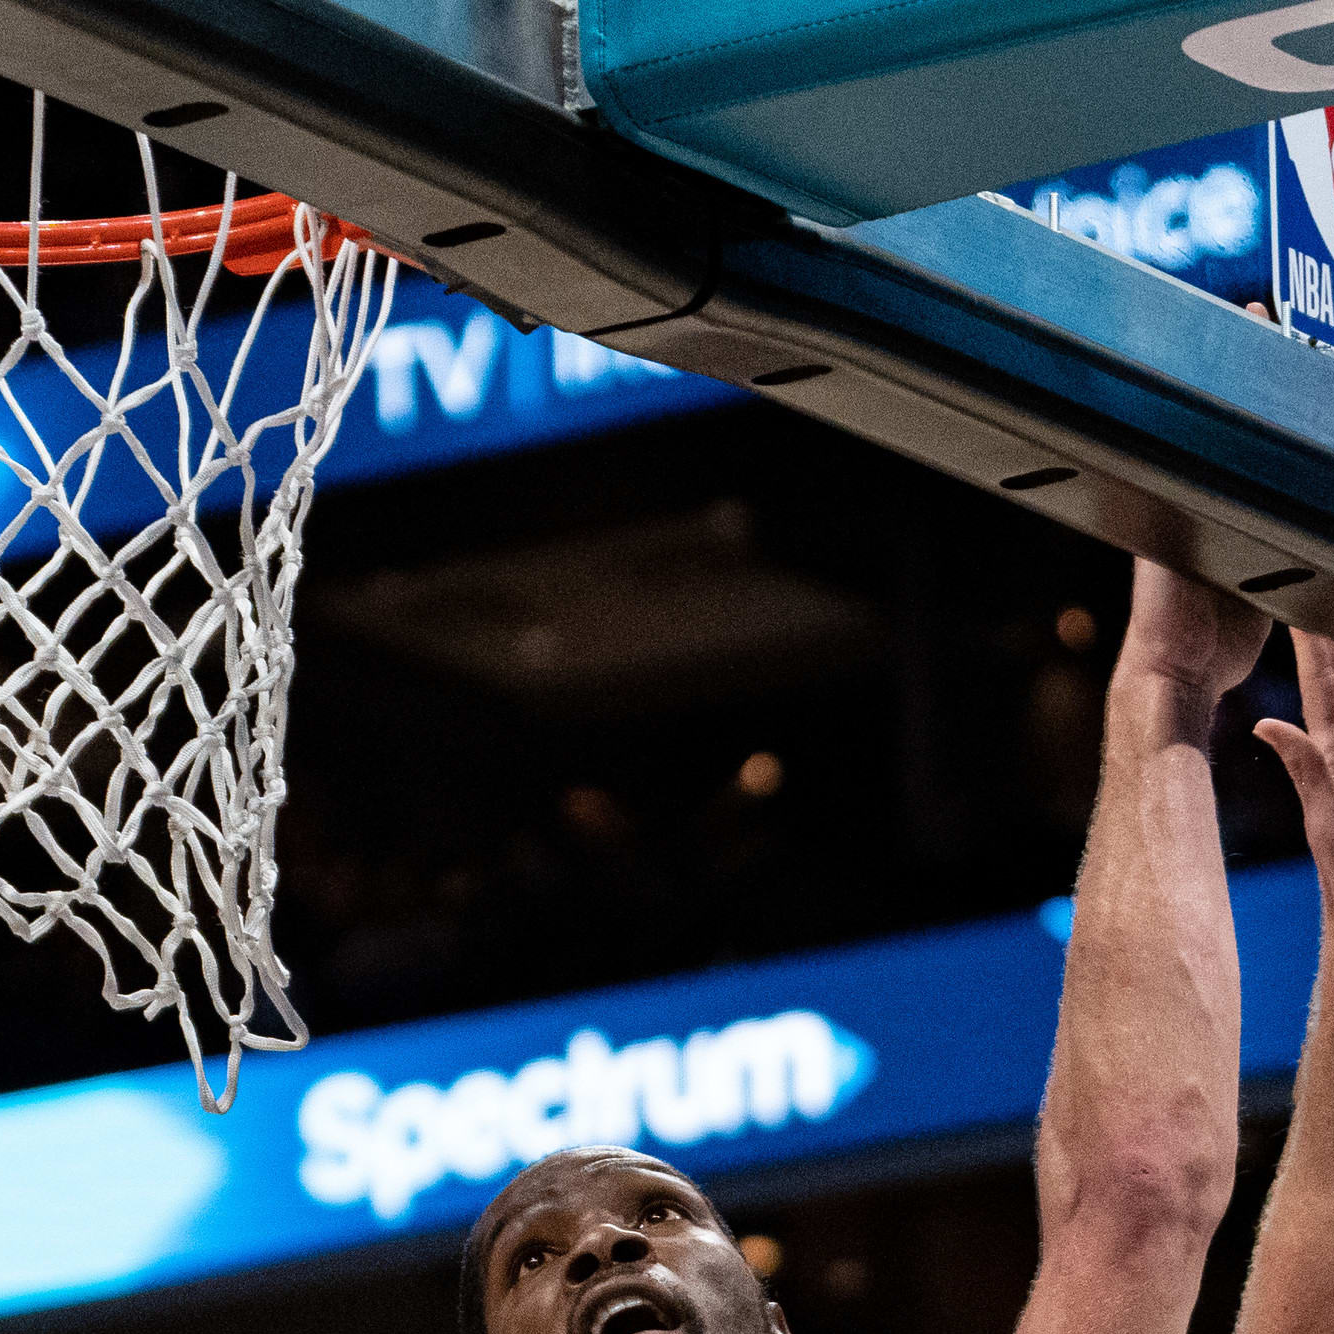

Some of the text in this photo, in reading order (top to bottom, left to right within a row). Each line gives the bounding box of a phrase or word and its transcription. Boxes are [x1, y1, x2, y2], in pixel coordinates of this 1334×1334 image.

[1033, 163, 1261, 270] oice
[367, 306, 503, 434] TV
[297, 1009, 839, 1222] Spectrum
